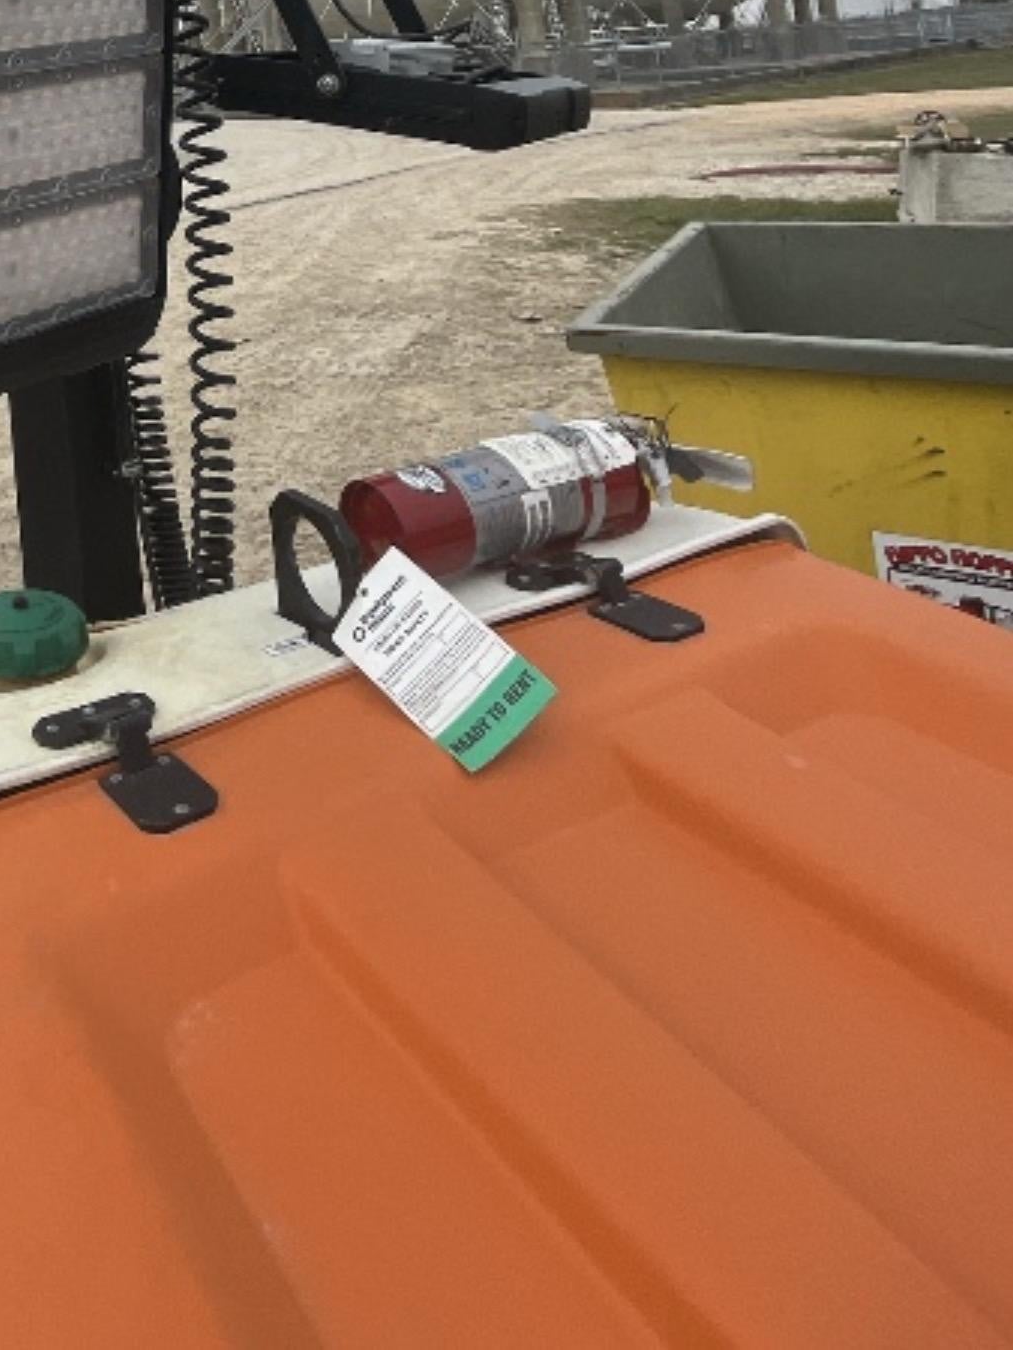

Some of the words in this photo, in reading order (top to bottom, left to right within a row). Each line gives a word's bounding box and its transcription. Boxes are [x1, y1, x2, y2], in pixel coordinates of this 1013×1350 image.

[448, 715, 492, 756] READY
[485, 700, 507, 723] TO
[502, 668, 537, 706] RENT
